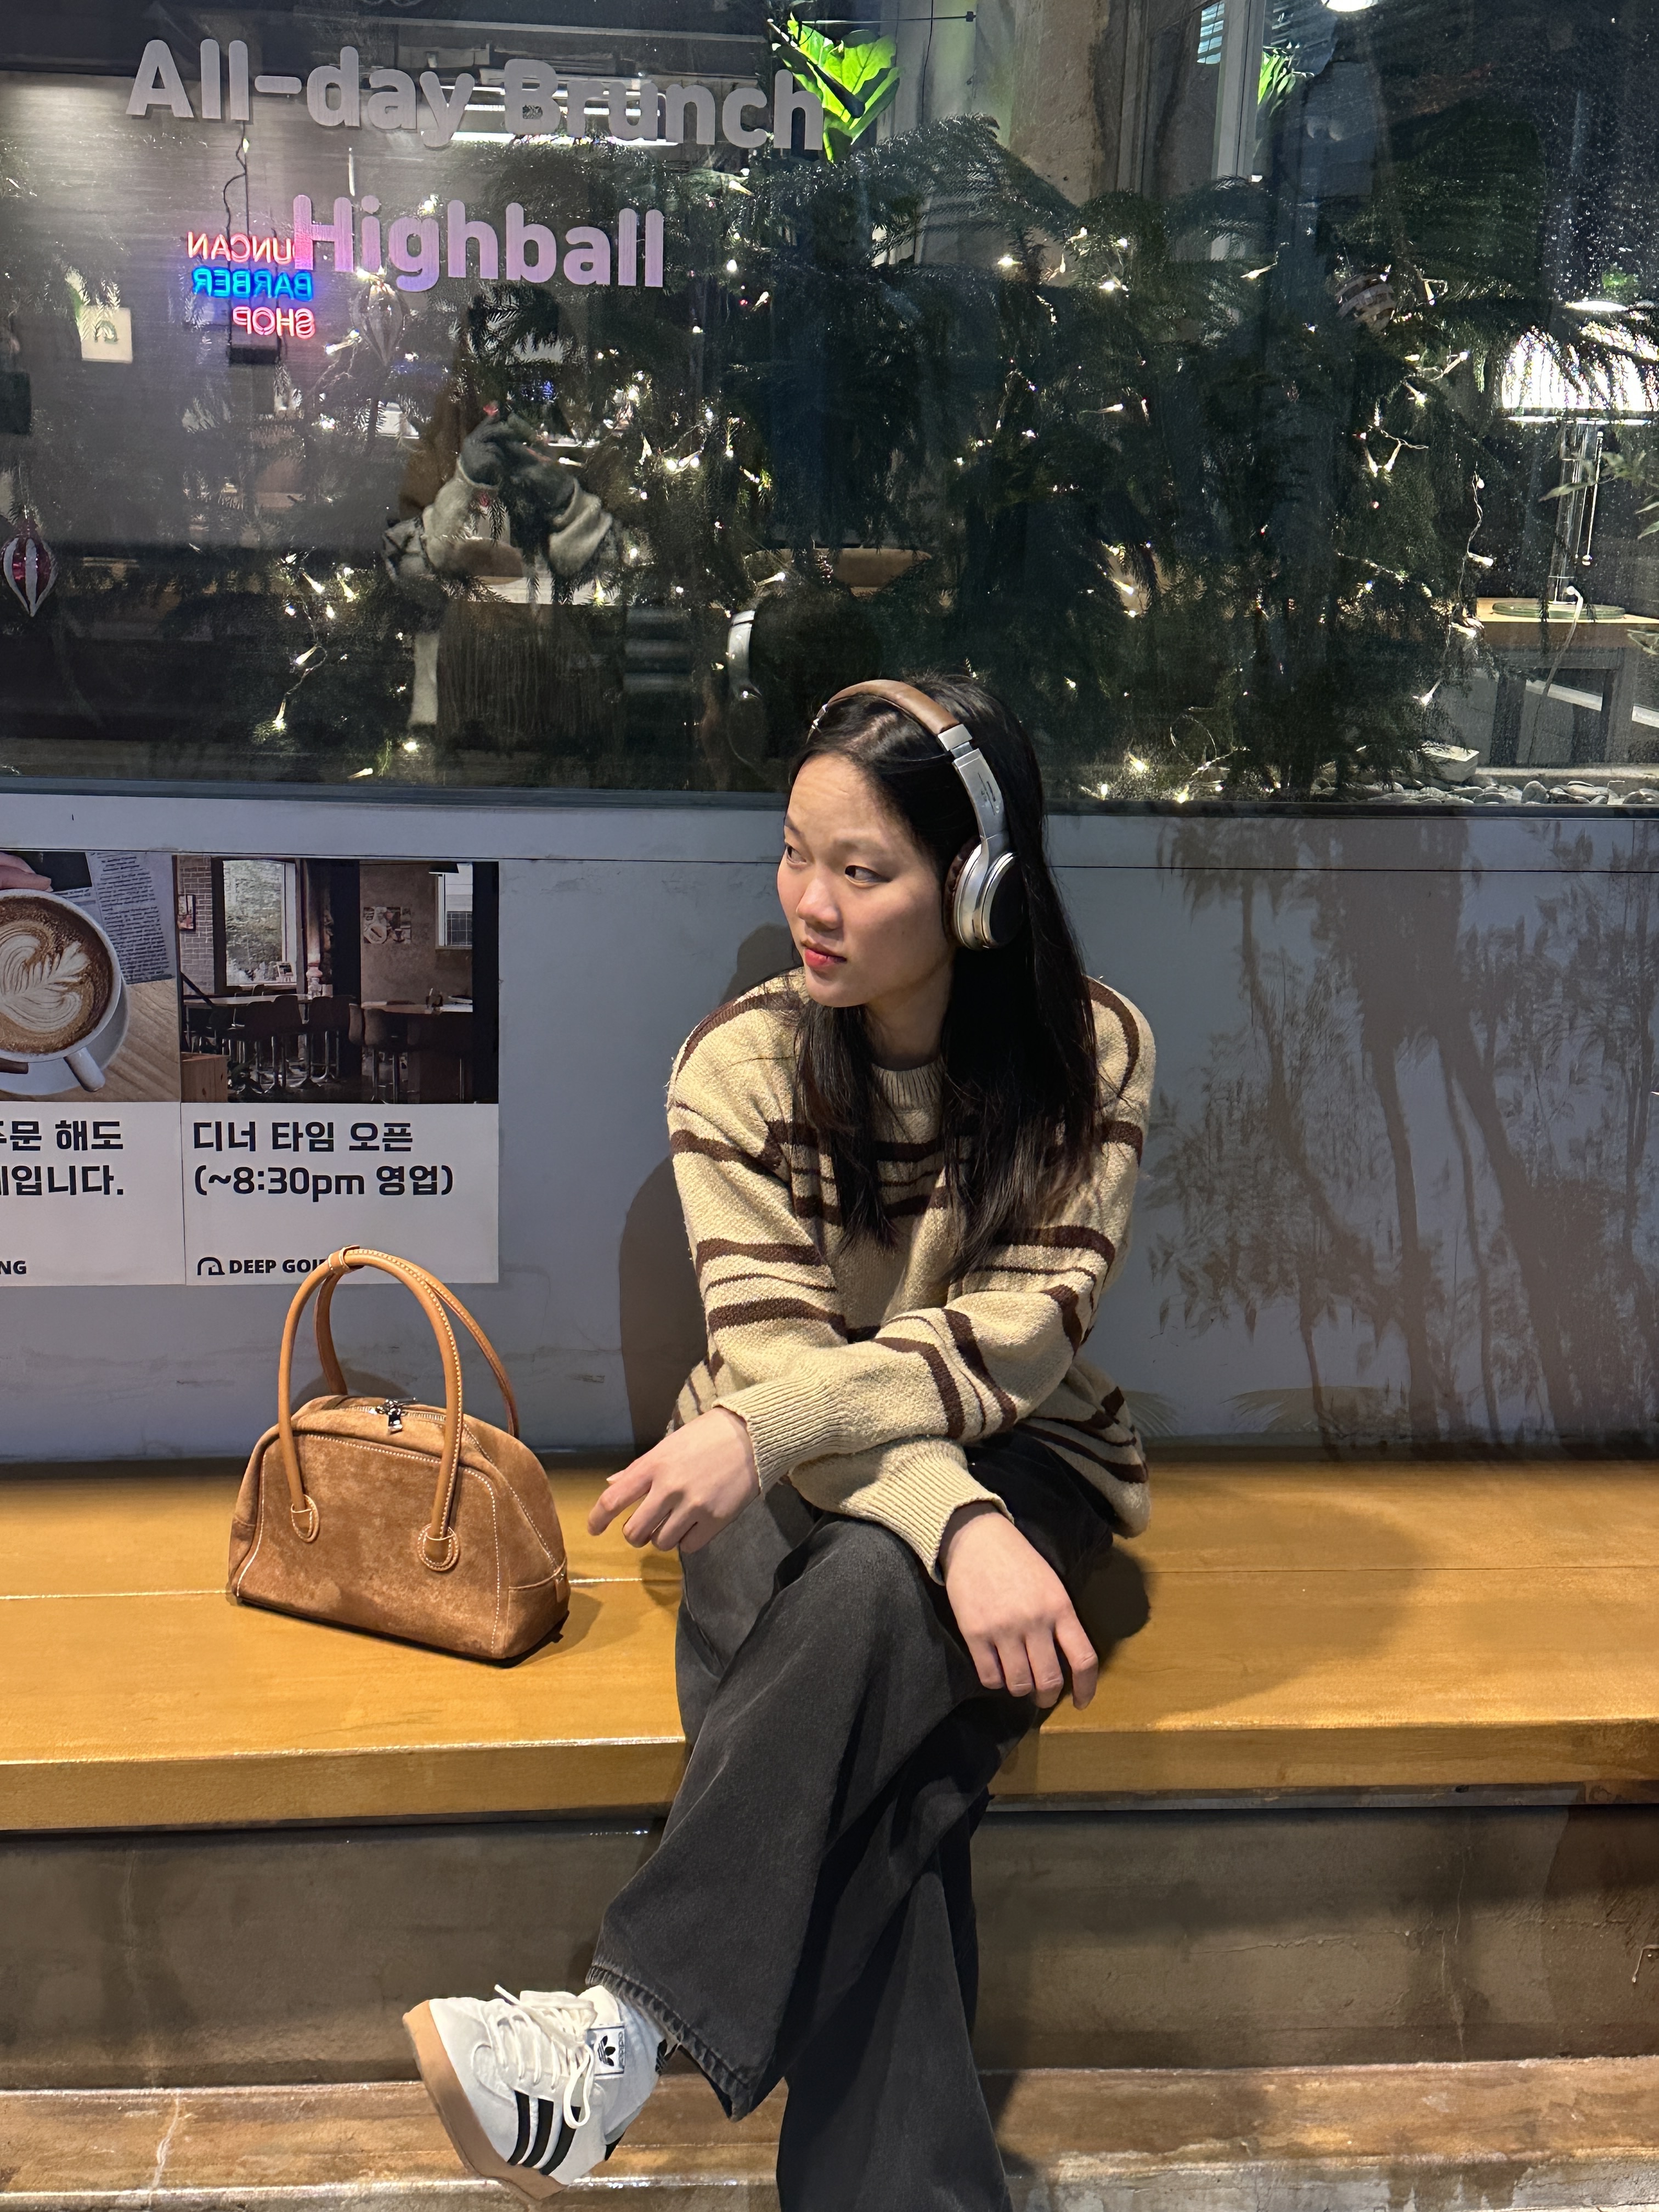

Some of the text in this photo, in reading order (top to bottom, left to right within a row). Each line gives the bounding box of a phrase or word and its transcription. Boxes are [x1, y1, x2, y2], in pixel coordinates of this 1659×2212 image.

[126, 38, 824, 150] All-day Brunch
[293, 195, 664, 292] Highball
[0, 1120, 123, 1151] 문 해도
[194, 1121, 413, 1152] 디너 타임 오픈
[0, 1165, 123, 1195] 입니다.
[195, 1165, 453, 1202] (~8:30pm 영업)
[229, 1259, 328, 1273] DEEP GOI
